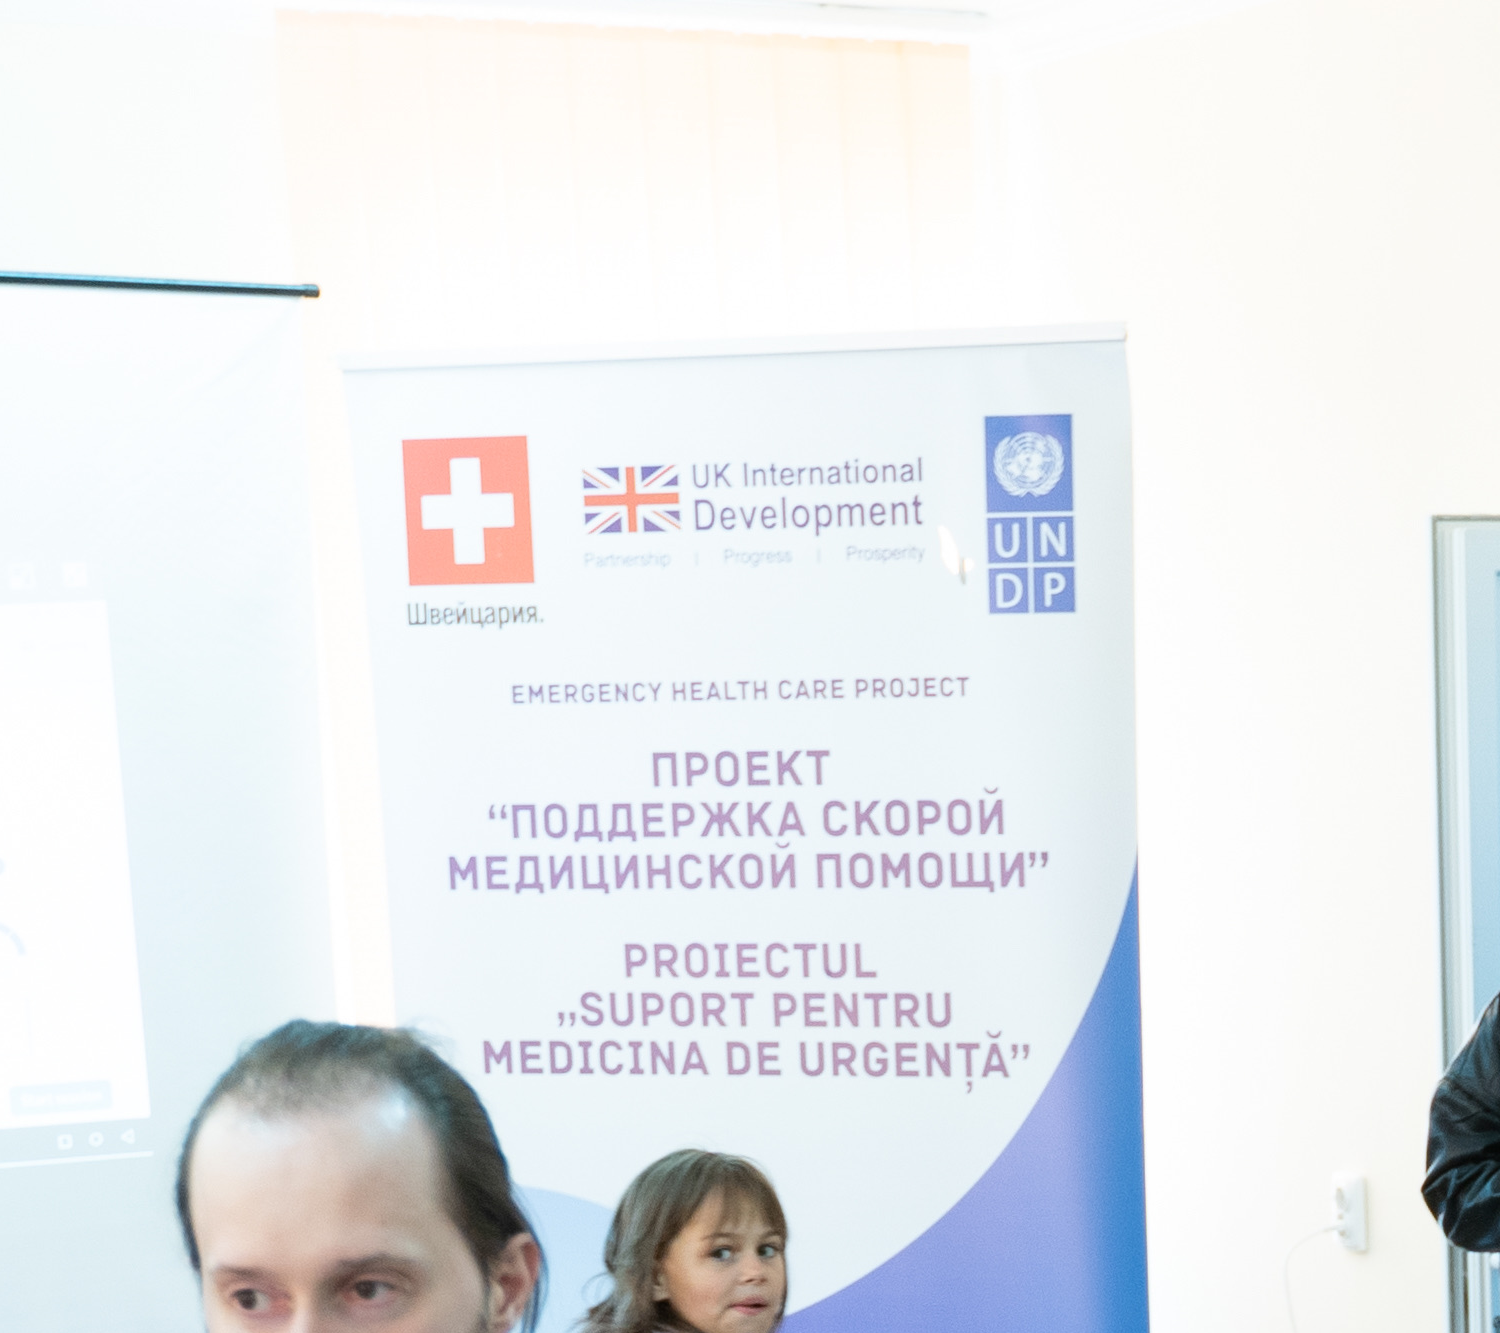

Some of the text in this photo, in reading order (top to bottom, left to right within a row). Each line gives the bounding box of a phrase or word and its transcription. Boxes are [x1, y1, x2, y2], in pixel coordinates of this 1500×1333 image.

[692, 456, 923, 489] UK International
[693, 494, 924, 537] Development
[583, 544, 926, 569] Partnership Progress Prosperity
[407, 602, 545, 629] Швейцария.
[511, 676, 970, 705] EMERGENCY HEALTH CARE PROJECT
[651, 749, 831, 788] ПРОЕКТ
[822, 786, 1005, 838] СКОРОЙ
[448, 842, 797, 895] МЕДИЦИНСКОЙ
[624, 942, 878, 979] PROIECTUL
[772, 991, 952, 1029] PENTRU
[482, 1039, 710, 1076] MEDICINA
[725, 1040, 782, 1077] DE
